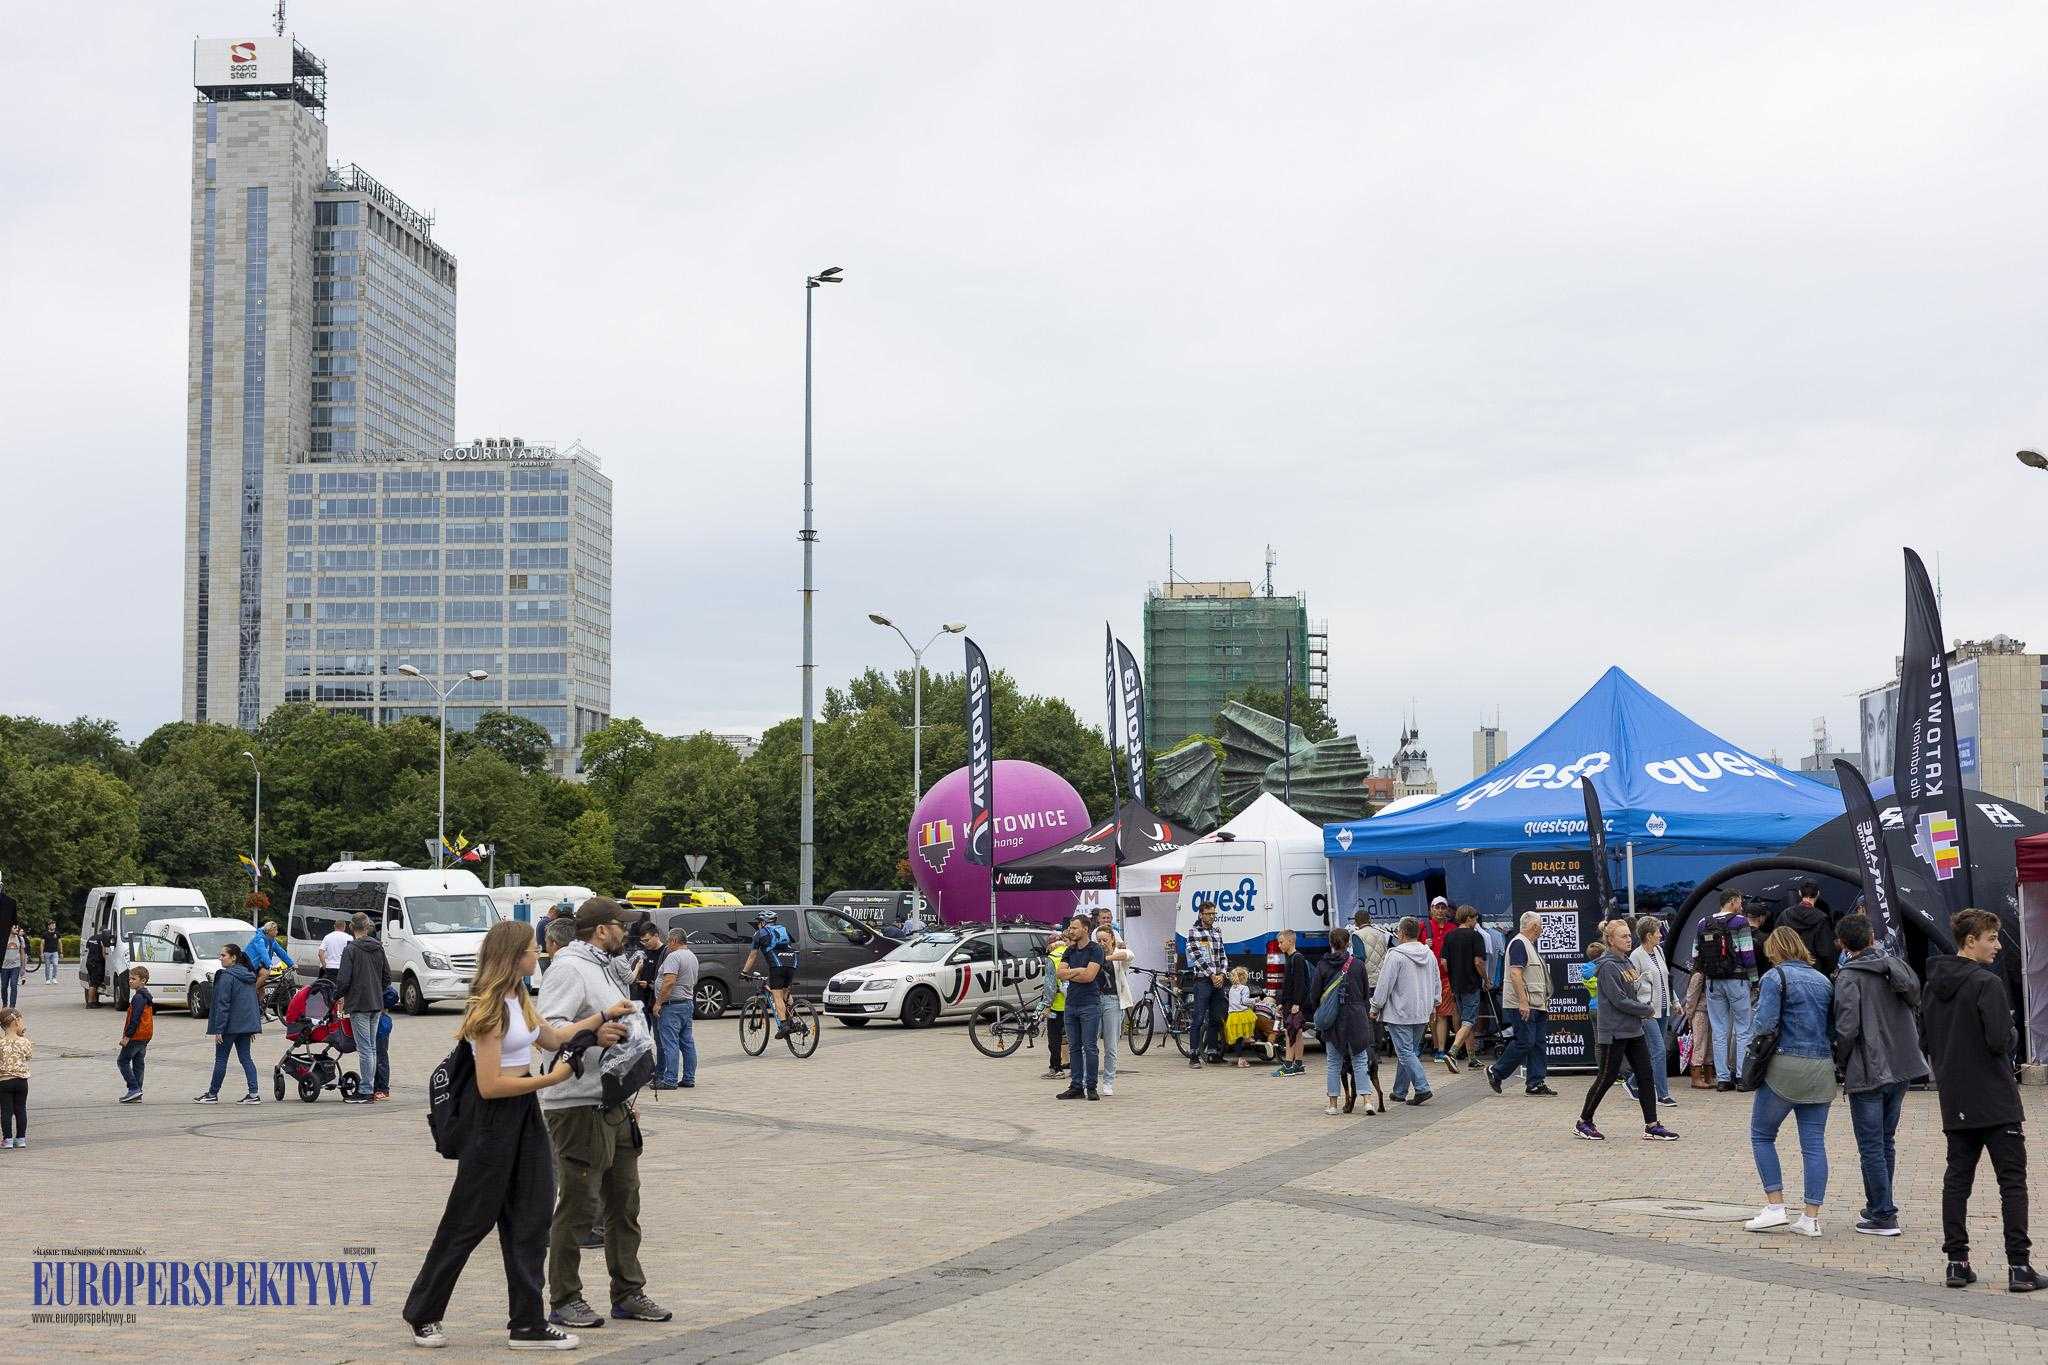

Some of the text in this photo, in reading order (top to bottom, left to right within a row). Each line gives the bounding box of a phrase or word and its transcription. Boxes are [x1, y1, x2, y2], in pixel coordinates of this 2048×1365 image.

[231, 64, 257, 72] sopra
[231, 71, 257, 79] steria
[443, 447, 553, 461] COURTYARD
[961, 809, 1068, 839] KTOWICE
[994, 836, 1024, 849] hange
[1568, 861, 1581, 871] DO
[1003, 872, 1032, 885] vittoria
[1523, 873, 1585, 887] VITARADE
[1358, 897, 1399, 916] eam
[1566, 900, 1579, 909] NA
[852, 907, 886, 921] DRUTEX
